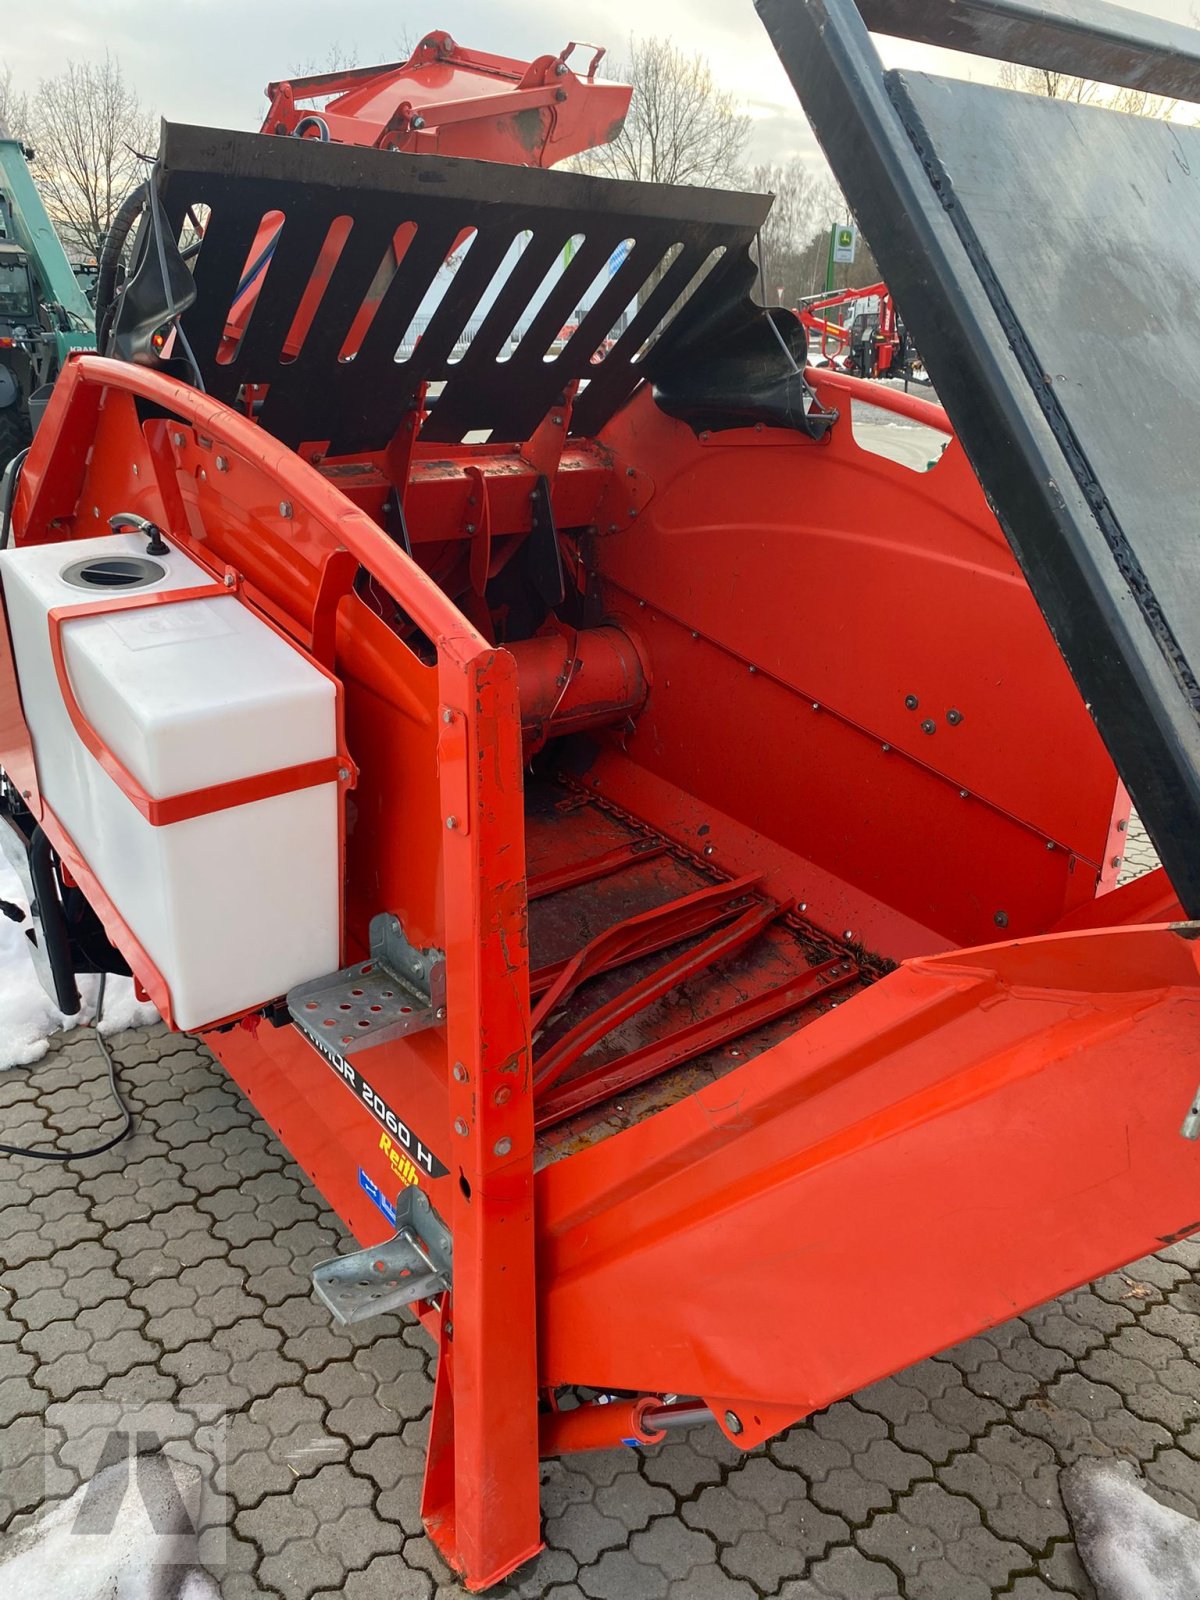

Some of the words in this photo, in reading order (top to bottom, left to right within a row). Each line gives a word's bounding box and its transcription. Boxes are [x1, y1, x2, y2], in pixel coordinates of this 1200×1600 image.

[362, 1082, 410, 1148] 2060
[417, 1142, 432, 1173] H
[379, 1132, 419, 1187] Reith
